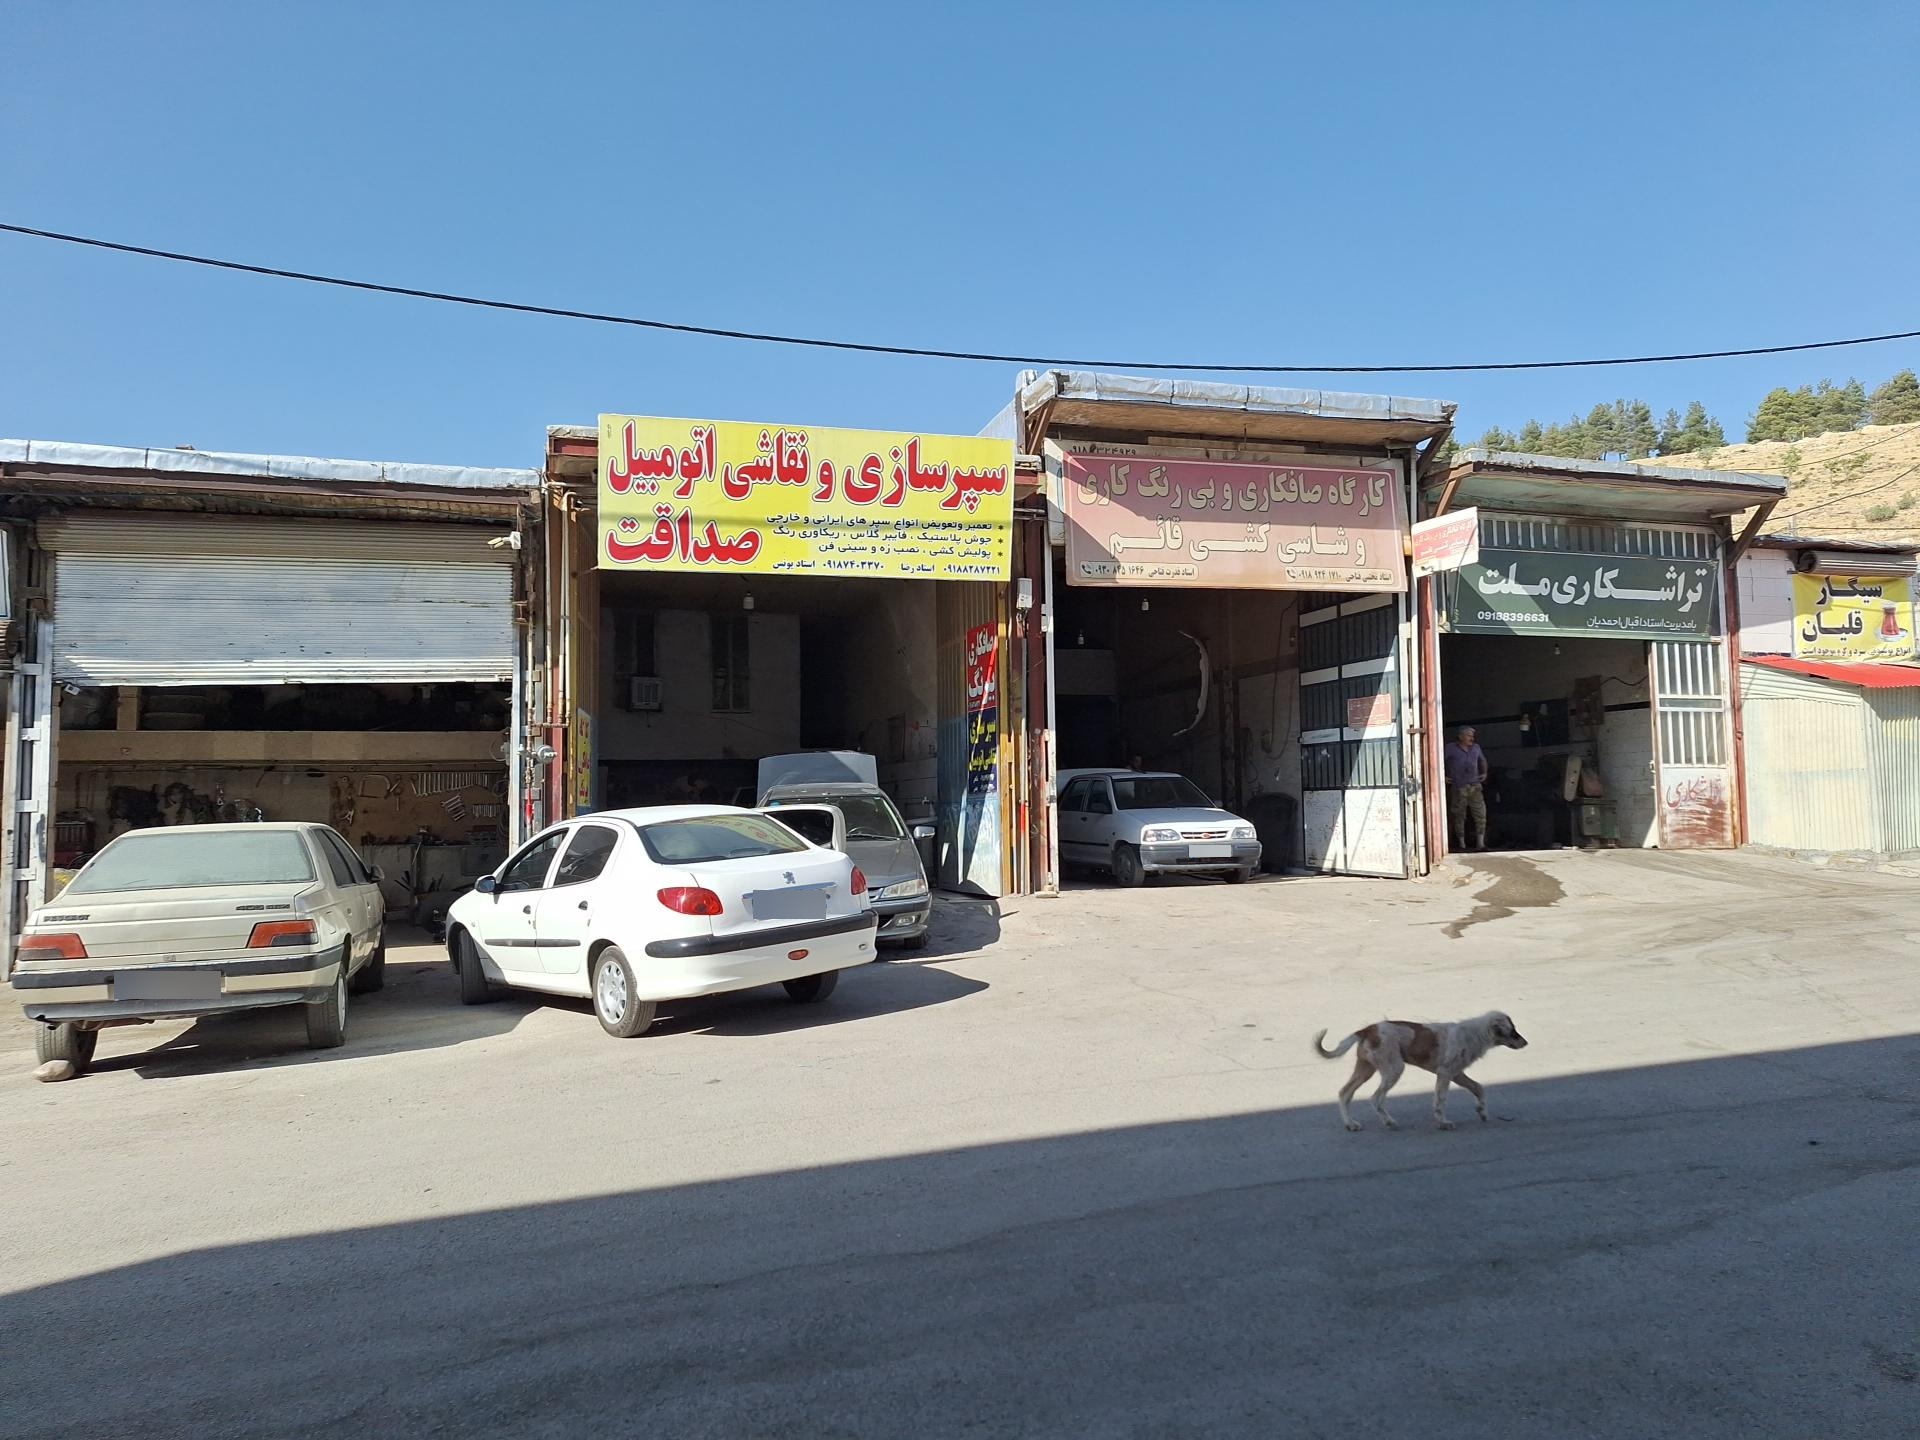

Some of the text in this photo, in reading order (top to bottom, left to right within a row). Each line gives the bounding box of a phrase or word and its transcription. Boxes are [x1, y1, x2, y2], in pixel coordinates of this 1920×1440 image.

[606, 419, 717, 499] اتومبیل
[722, 428, 811, 500] نقاشی
[813, 459, 835, 503] و
[1076, 463, 1131, 506] کاری
[1136, 466, 1182, 508] رنگ
[1186, 476, 1217, 510] بی
[1221, 478, 1234, 511] و
[1237, 469, 1324, 512] صافکاری
[766, 513, 800, 526] خارجی
[803, 516, 810, 526] و
[812, 515, 844, 527] ایرانی
[848, 516, 866, 526] های
[870, 518, 891, 530] سپر
[894, 518, 919, 530] انواع
[772, 526, 796, 538] رنگ
[965, 521, 993, 531] تعمیر
[605, 503, 763, 565] صداقت
[798, 528, 840, 540] ریکاوری
[882, 531, 907, 543] فایبر
[916, 531, 962, 544] پلاستیک
[964, 536, 992, 544] جوش
[1108, 514, 1184, 559] قائم
[1187, 520, 1272, 561] کشی
[1276, 523, 1351, 563] شاسی
[818, 542, 835, 552] فن
[838, 543, 868, 554] سینی
[871, 545, 878, 555] و
[880, 543, 891, 556] زه
[894, 545, 920, 556] نصب
[929, 545, 954, 557] کشی
[1354, 537, 1367, 566] و
[957, 548, 992, 560] پولیش
[772, 558, 794, 570] یونس
[796, 560, 816, 568] استاد
[900, 563, 914, 574] رضا
[916, 564, 935, 572] استاد
[1477, 561, 1708, 613] تراشکاری ملت
[1816, 576, 1883, 606] سیگار
[1477, 610, 1549, 622] 09188396631
[1802, 610, 1864, 642] قلیان
